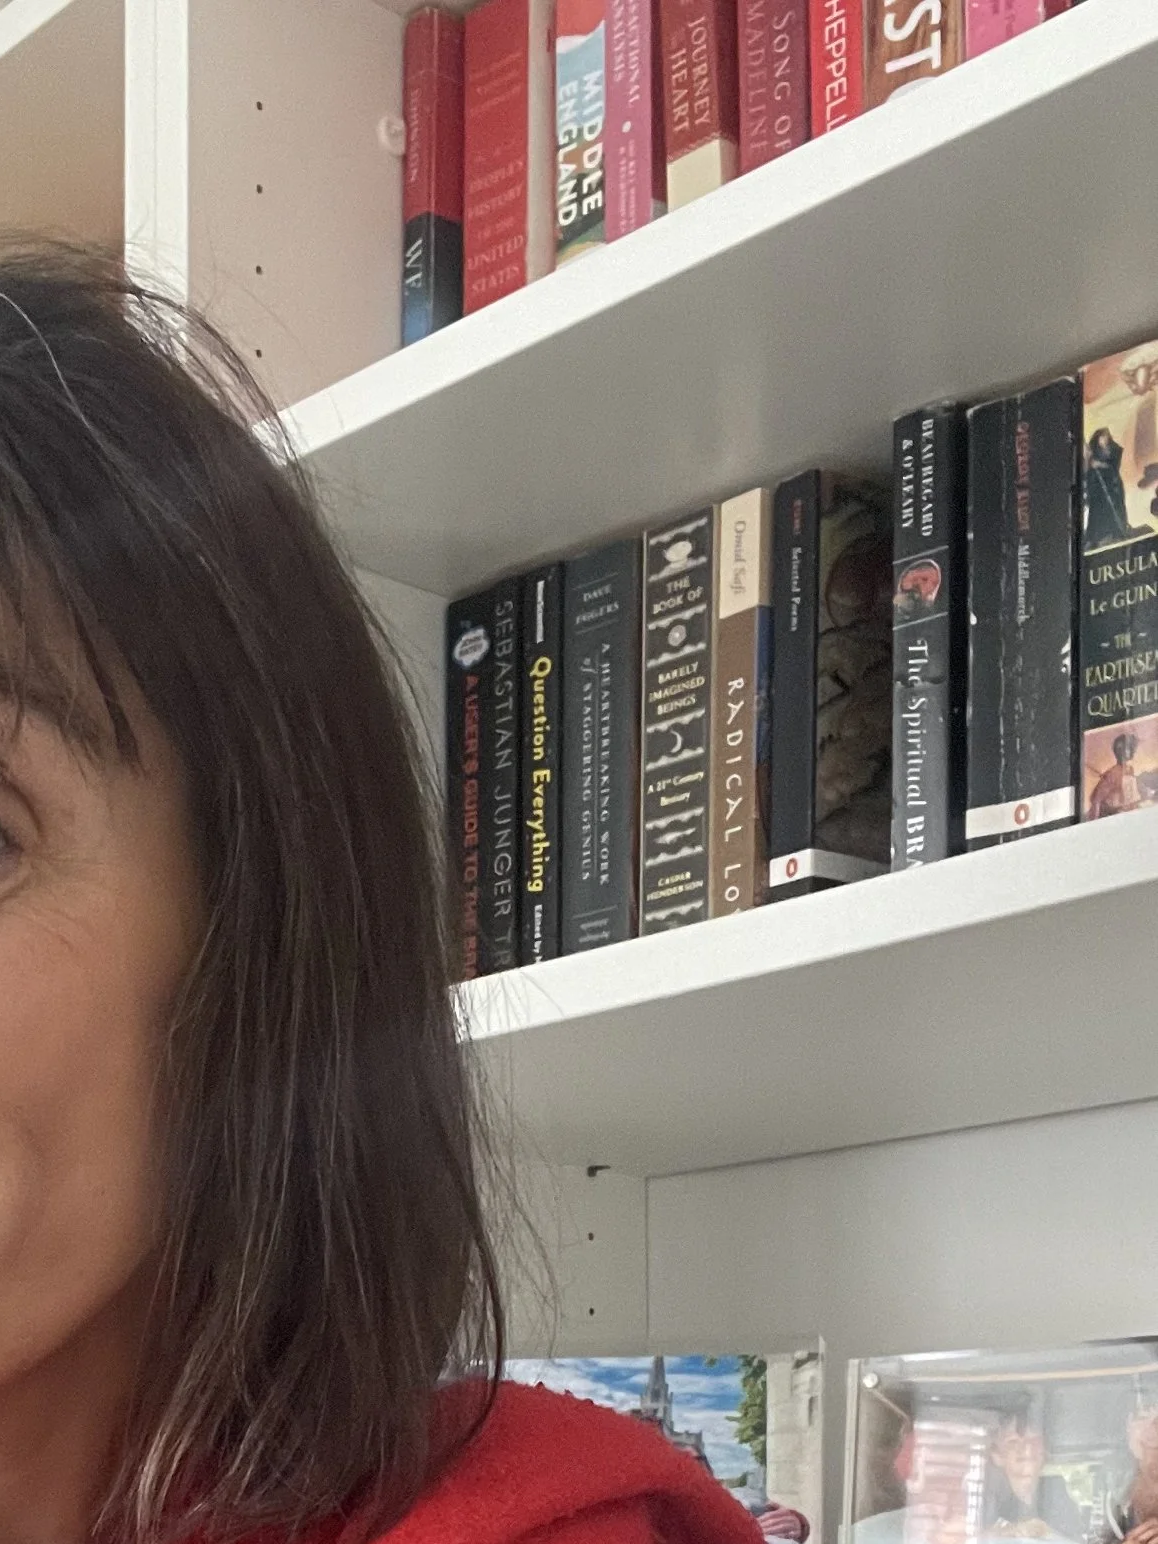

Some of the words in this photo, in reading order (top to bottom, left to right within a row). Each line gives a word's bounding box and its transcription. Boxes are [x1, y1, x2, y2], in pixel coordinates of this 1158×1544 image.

[688, 15, 711, 126] JOURNEY
[772, 10, 796, 101] SONG
[883, 0, 941, 76] ST
[669, 47, 689, 133] HEART
[744, 0, 768, 153] MADELINE
[557, 79, 579, 227] ENGLAND
[581, 70, 604, 214] MIDDLE
[772, 114, 795, 151] OF
[920, 418, 935, 538] BEAUREGARD
[583, 583, 613, 603] DAVE
[653, 595, 684, 615] BOOK
[687, 585, 705, 602] OF
[666, 576, 691, 594] THE
[1089, 550, 1158, 585] URSULA
[1112, 583, 1158, 609] GUIN
[494, 600, 514, 771] SEBASTIAN
[601, 643, 611, 654] A
[658, 661, 699, 685] BARELY
[907, 639, 929, 685] The
[529, 656, 552, 762] Question
[648, 676, 706, 704] IMAGINED
[657, 695, 697, 716] BEINGS
[581, 682, 594, 802] STAGGERING
[600, 663, 612, 822] HEARTBREAKING
[724, 678, 745, 842] RADICAL
[902, 697, 929, 808] Spiritual
[463, 779, 480, 848] GUIDE
[492, 785, 512, 918] JUNGER
[526, 769, 551, 894] Everything
[581, 810, 593, 881] GENIUS
[463, 851, 480, 883] TO
[599, 831, 611, 886] WORK
